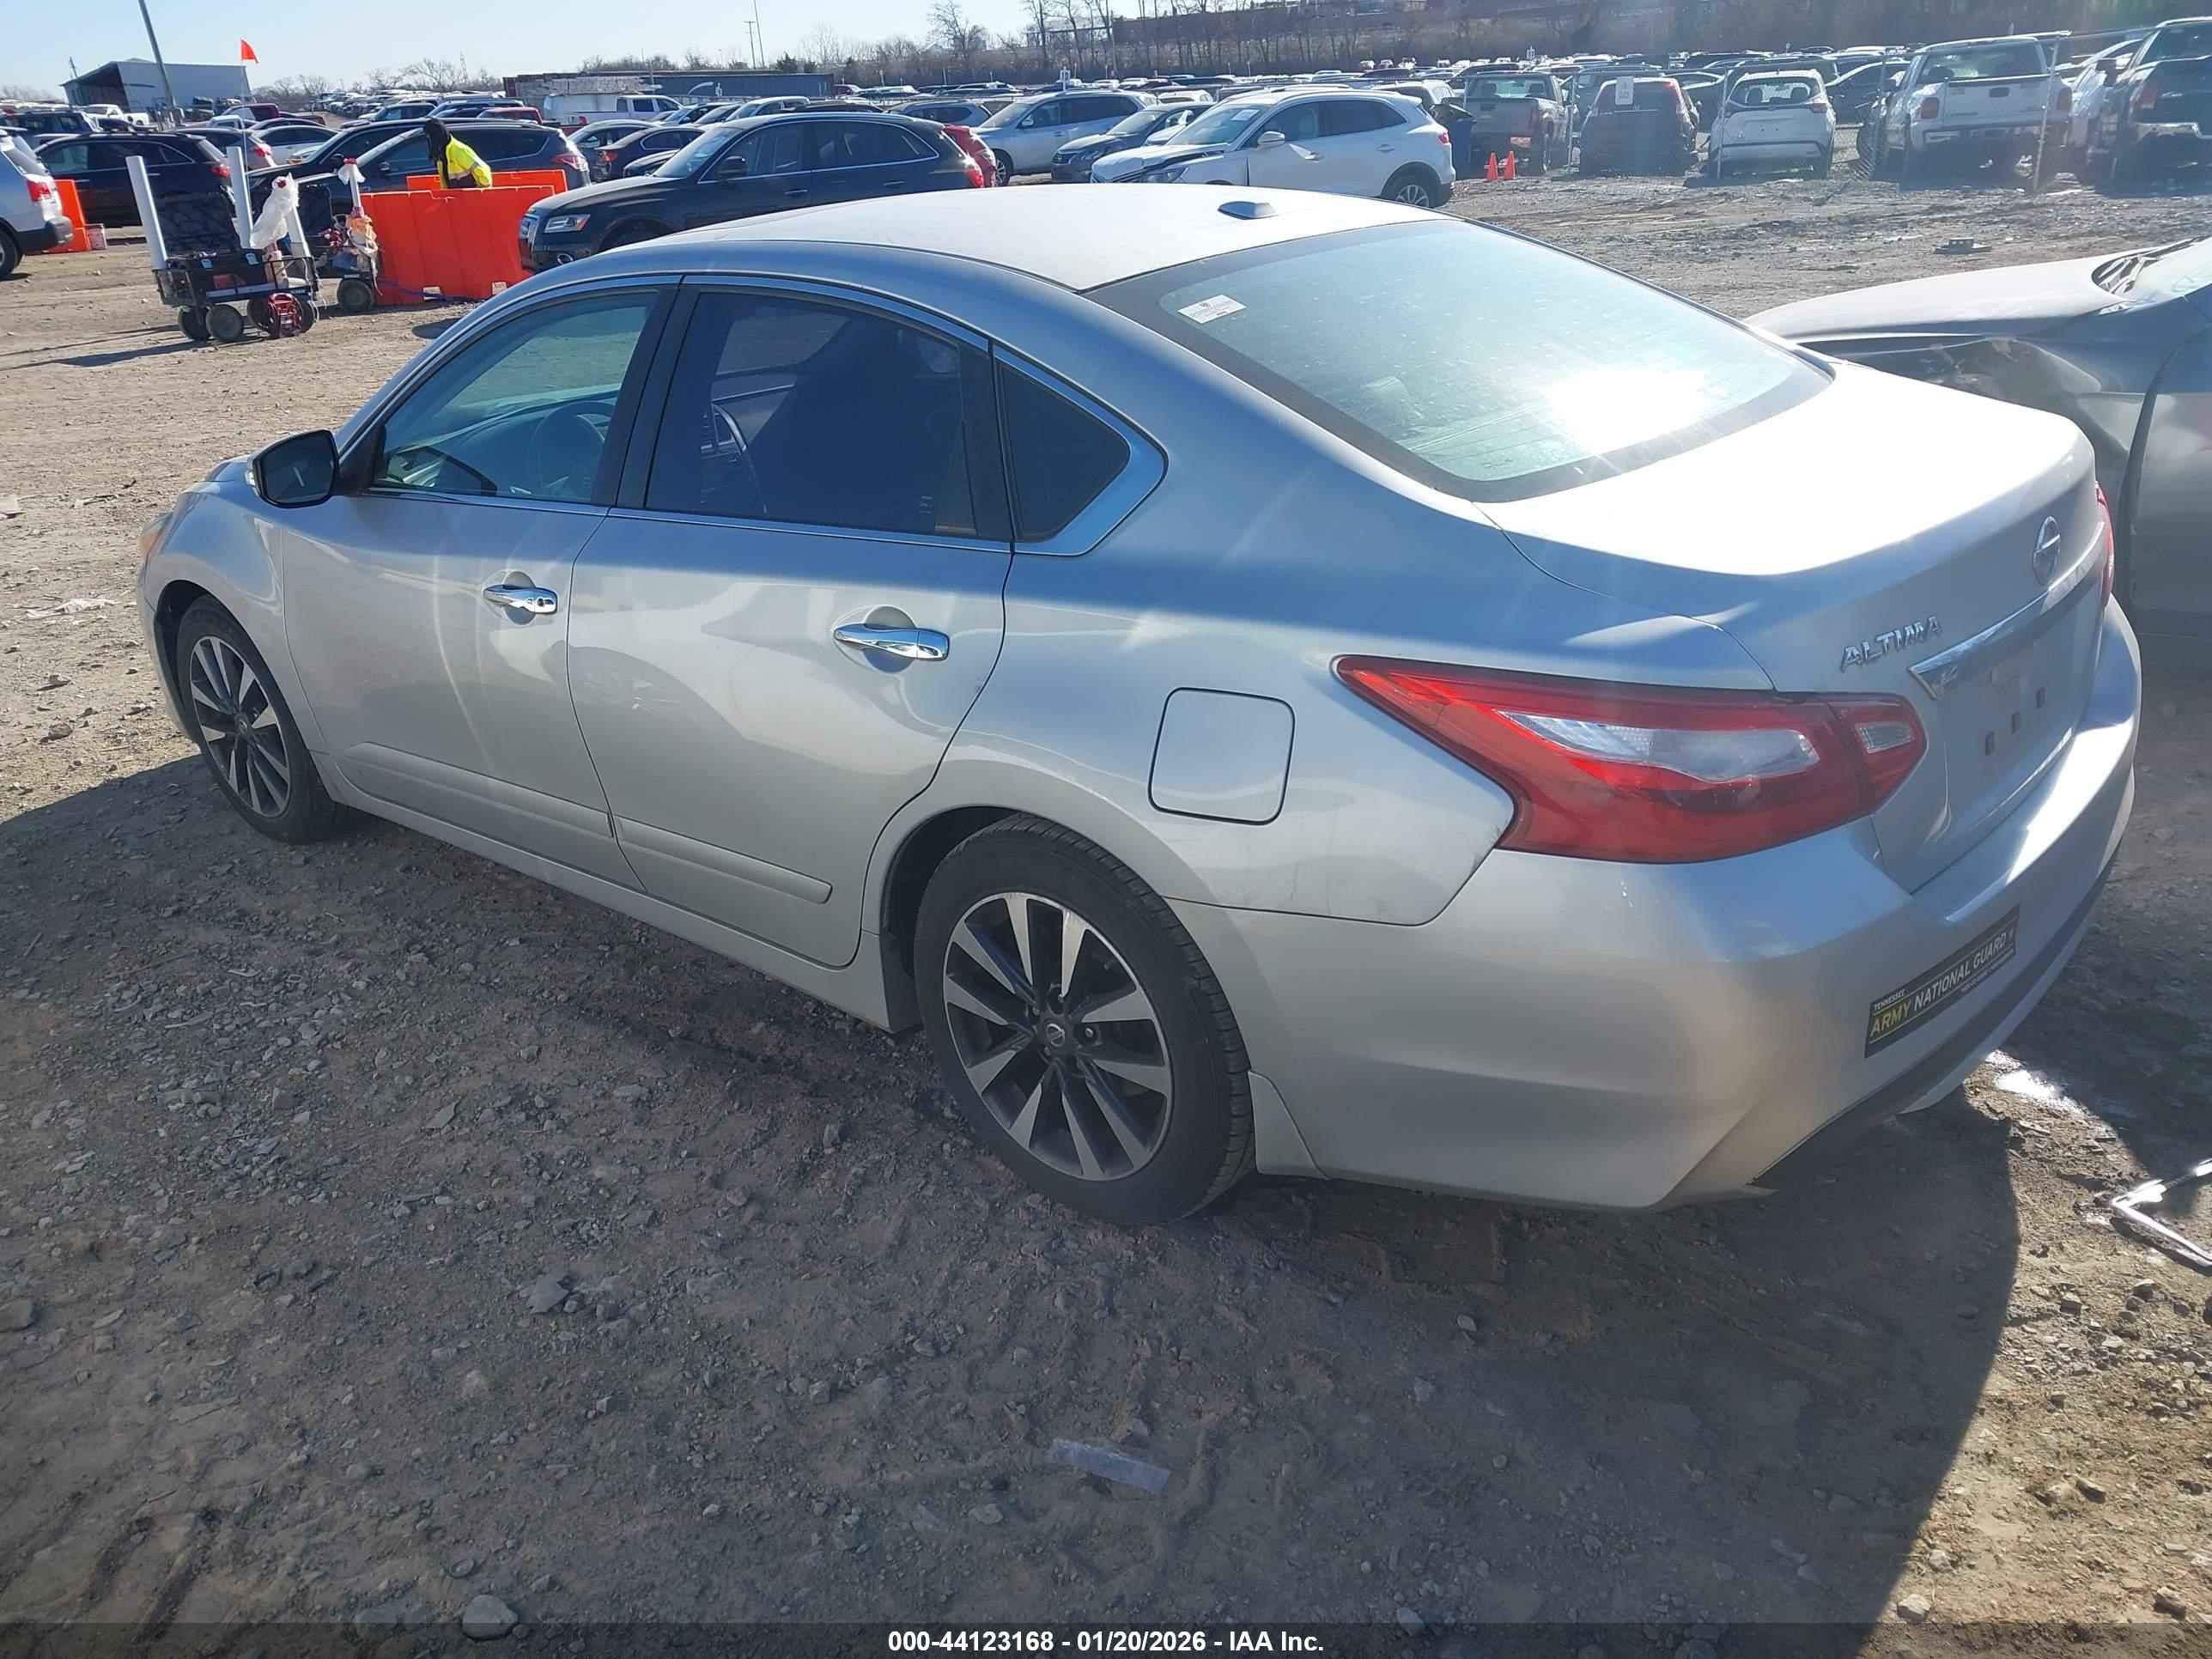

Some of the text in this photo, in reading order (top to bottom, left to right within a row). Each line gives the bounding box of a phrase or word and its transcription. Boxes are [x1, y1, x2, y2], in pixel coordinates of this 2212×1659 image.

[1840, 615, 1942, 673] ALTIMA
[1870, 1000, 1911, 1037] ARMY
[1913, 961, 1972, 1012] NATIONAL
[1972, 932, 2007, 969] GUARD
[1874, 988, 1906, 1011] TENNESSEE
